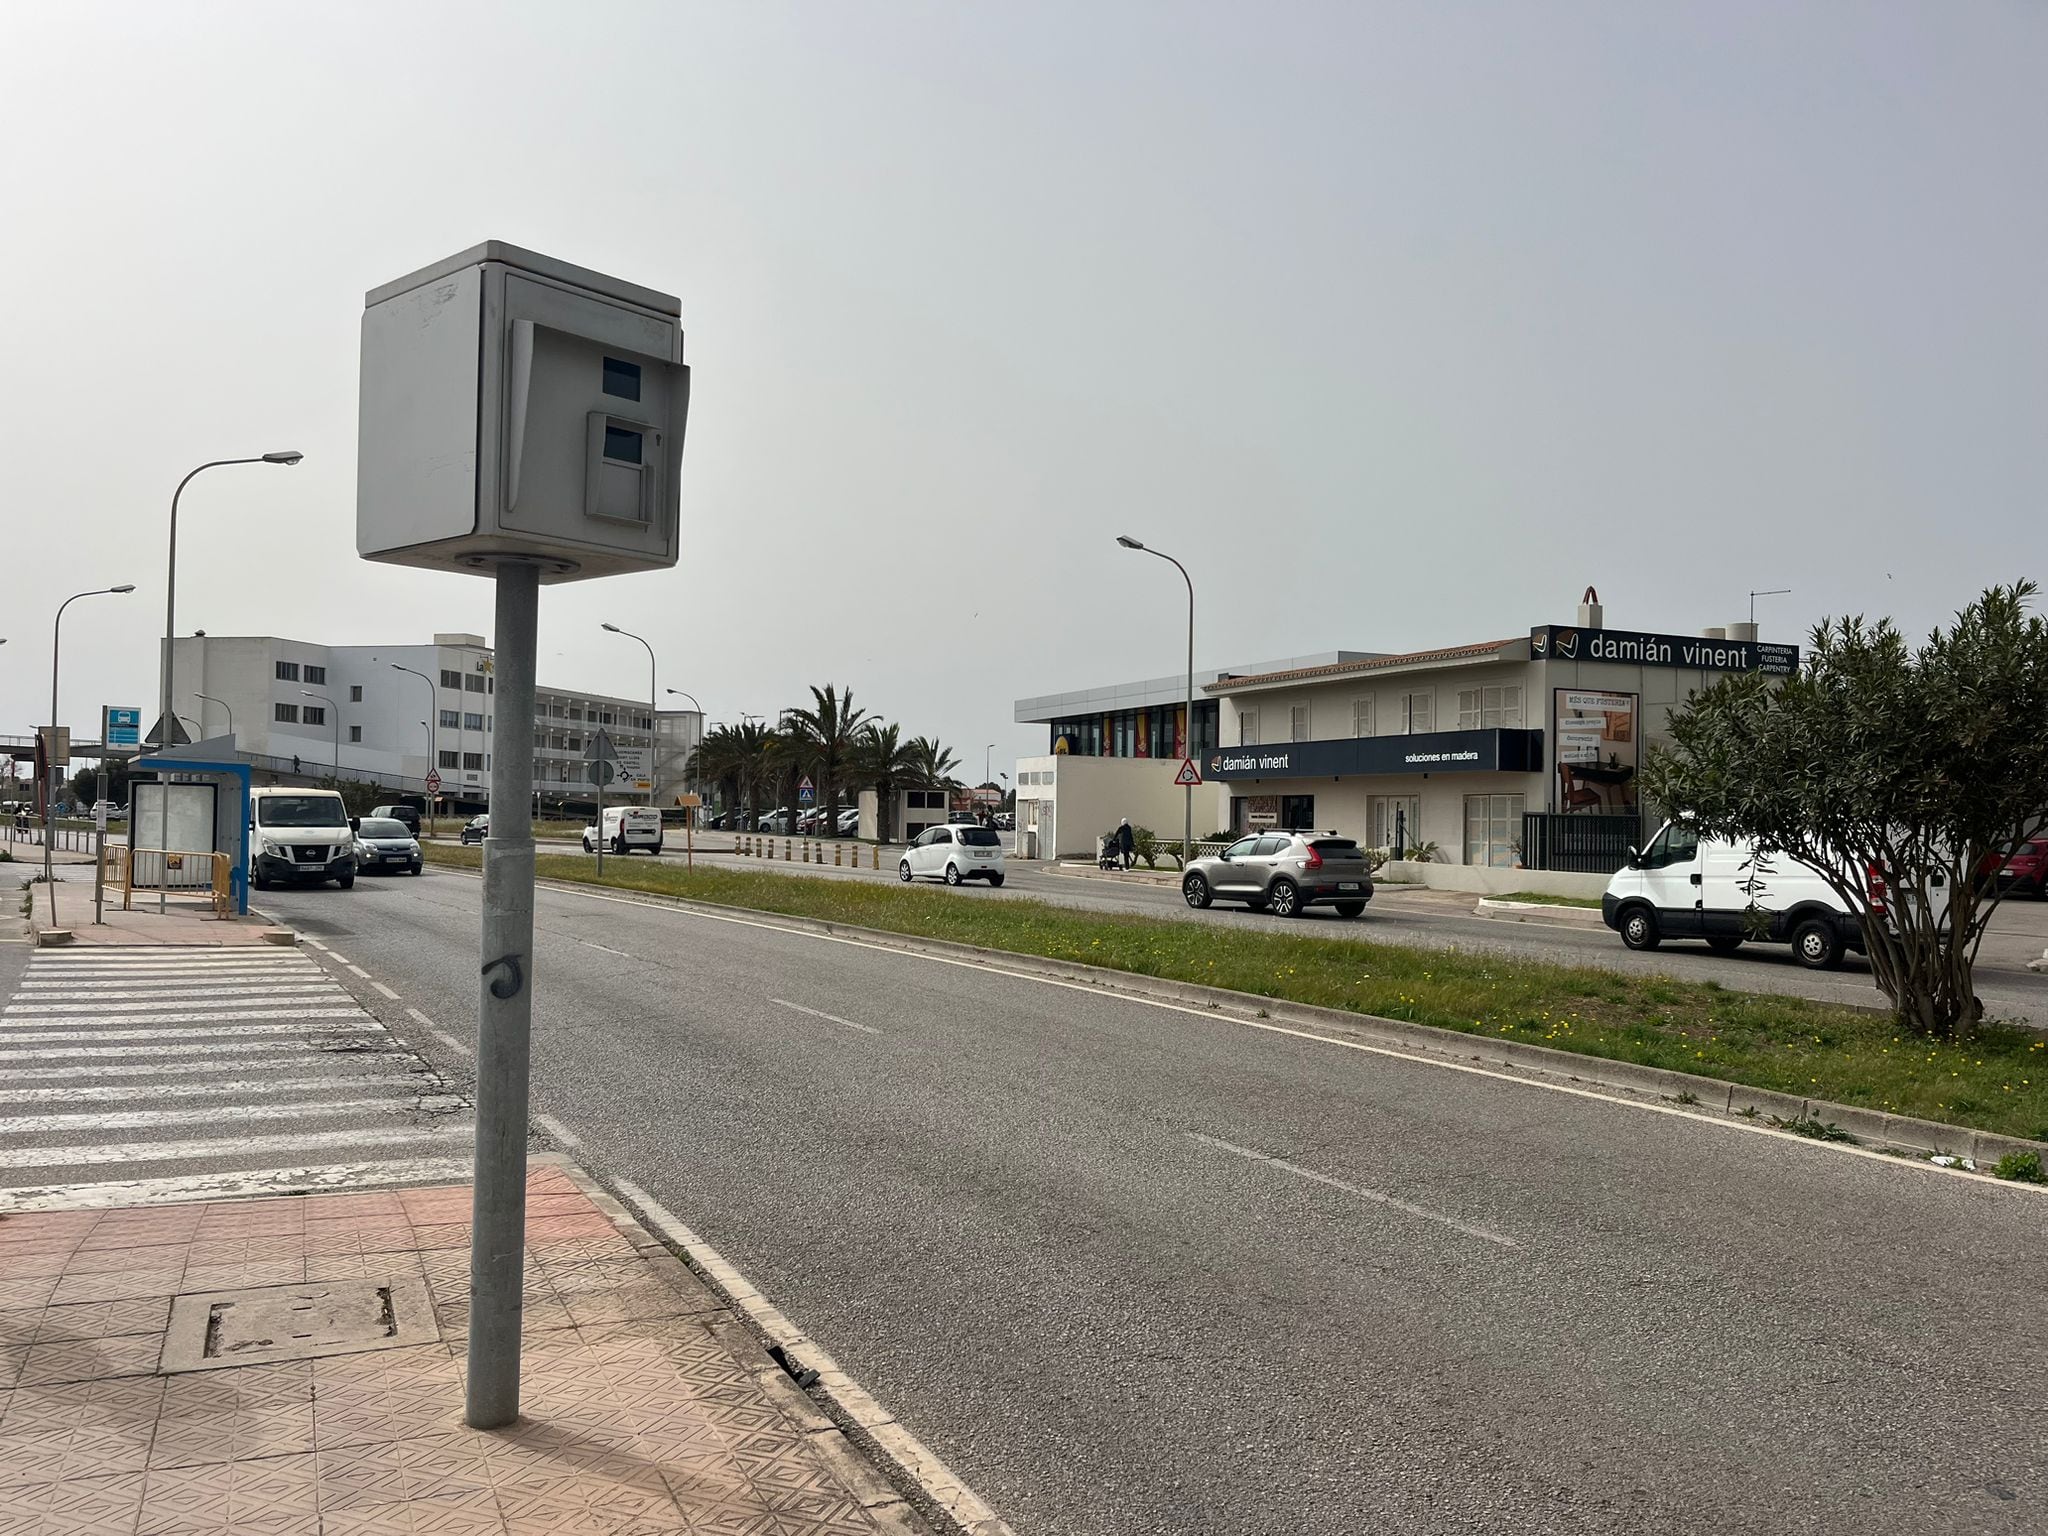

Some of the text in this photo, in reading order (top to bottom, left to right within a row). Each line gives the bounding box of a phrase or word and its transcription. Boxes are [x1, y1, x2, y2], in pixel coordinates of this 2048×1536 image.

[1590, 634, 1747, 667] damián vinent
[1761, 655, 1787, 663] FUSTERIA
[1758, 664, 1790, 673] CARPENTRY
[1223, 754, 1288, 771] damián vinent
[1405, 750, 1478, 763] soluciones en madera
